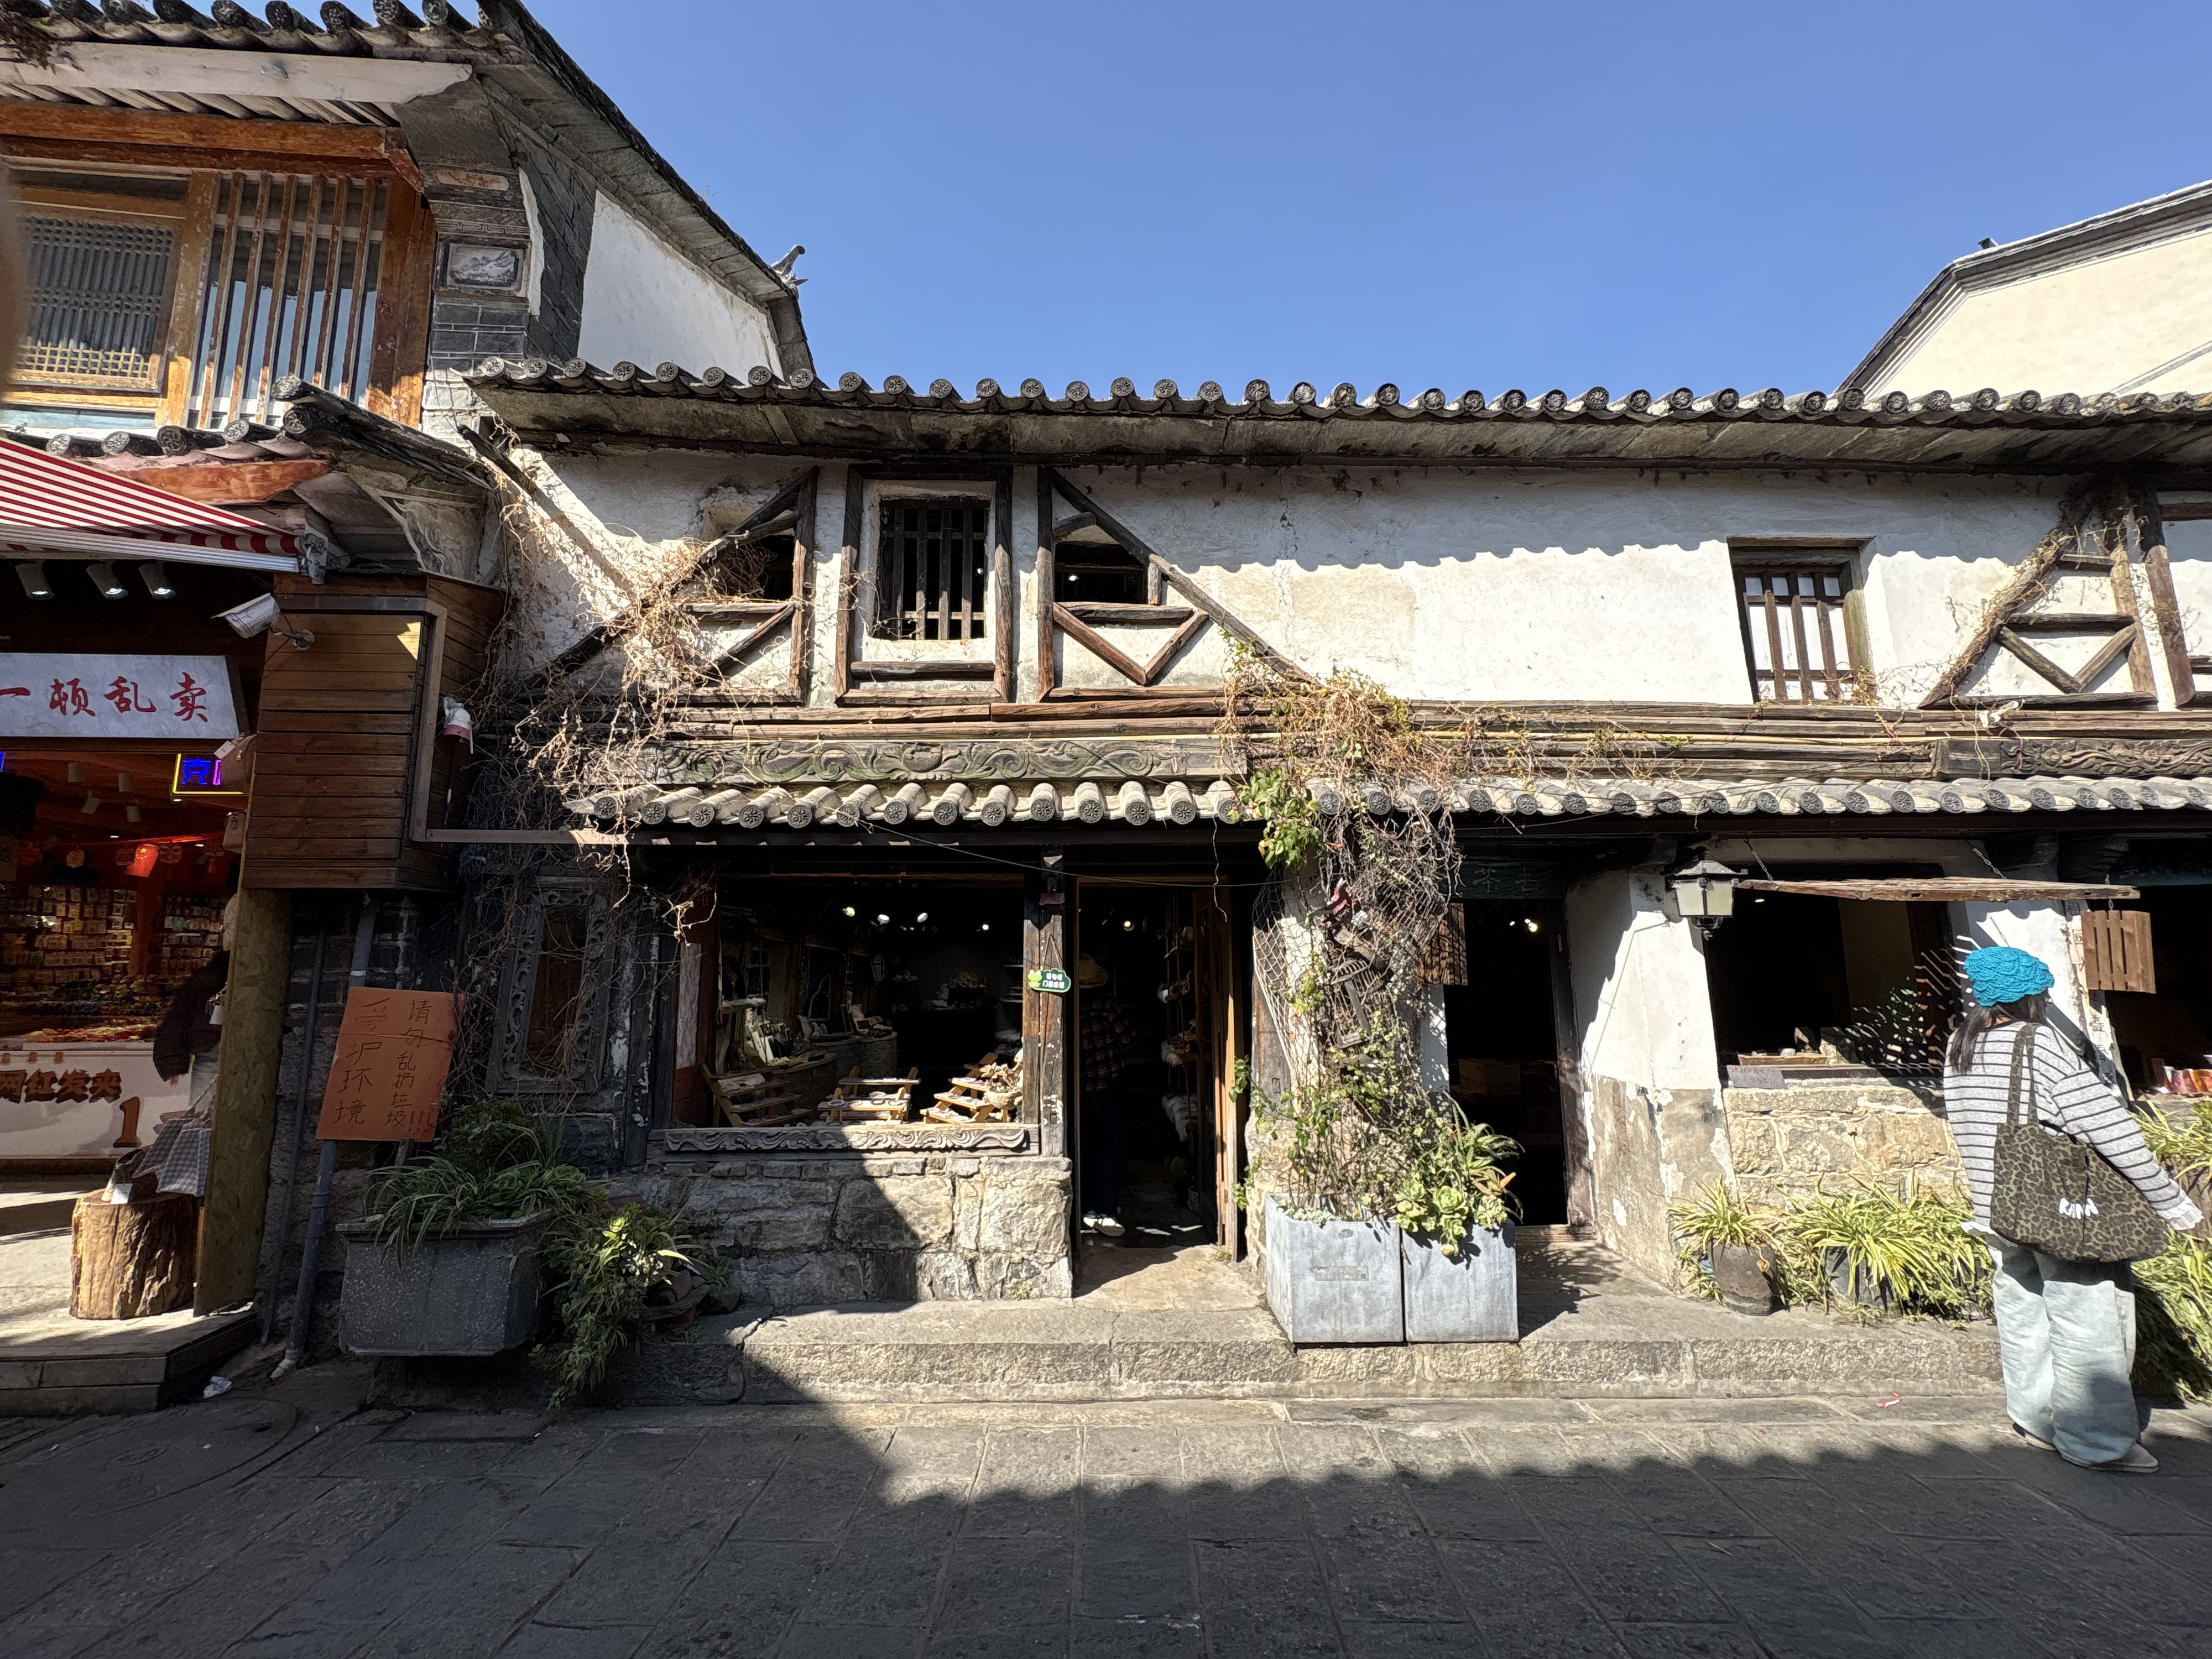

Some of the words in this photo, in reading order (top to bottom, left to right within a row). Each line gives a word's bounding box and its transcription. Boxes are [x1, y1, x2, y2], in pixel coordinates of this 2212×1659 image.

[0, 672, 208, 722] 一顿乱卖
[0, 1068, 122, 1104] 网红发夹
[333, 998, 390, 1124] 爱护环境
